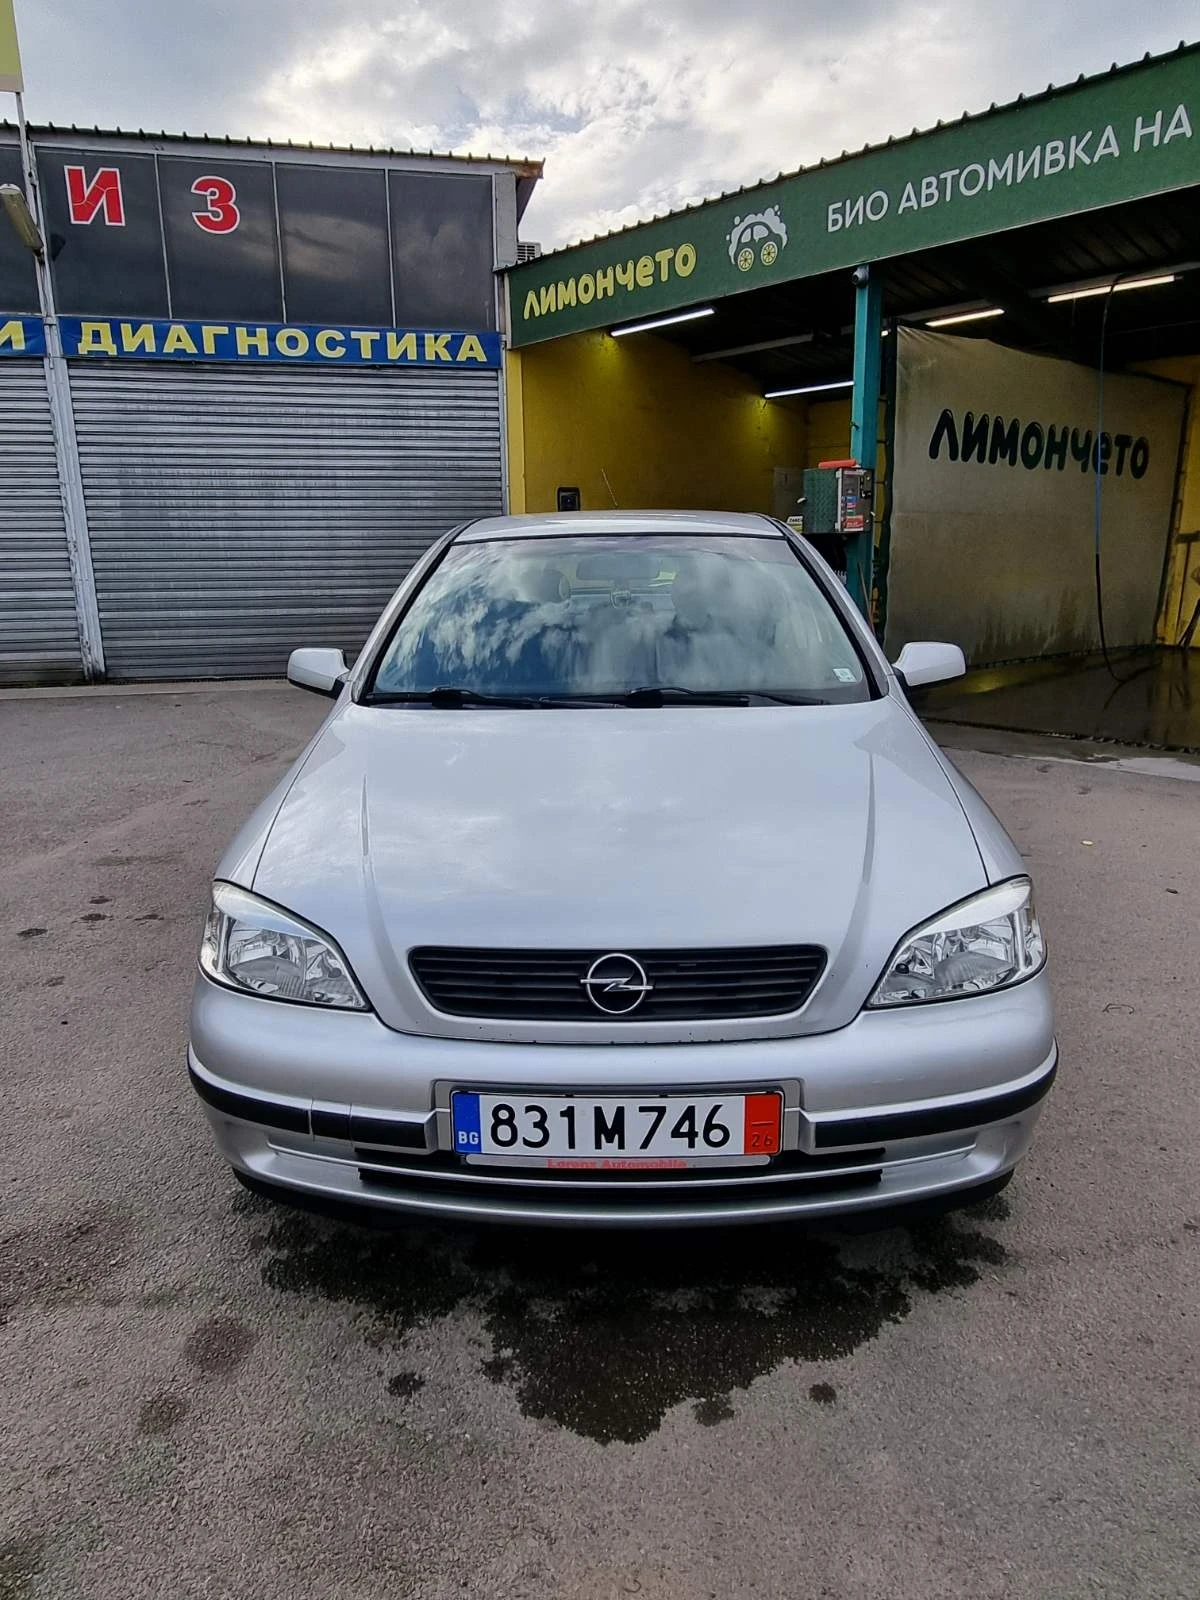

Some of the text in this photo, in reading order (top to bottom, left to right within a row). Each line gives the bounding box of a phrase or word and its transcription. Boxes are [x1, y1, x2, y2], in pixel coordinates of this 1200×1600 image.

[827, 104, 1193, 232] БИО АВТОМИВКА НА
[78, 322, 488, 362] ДИАГНОСТИКА
[458, 1130, 480, 1146] BG
